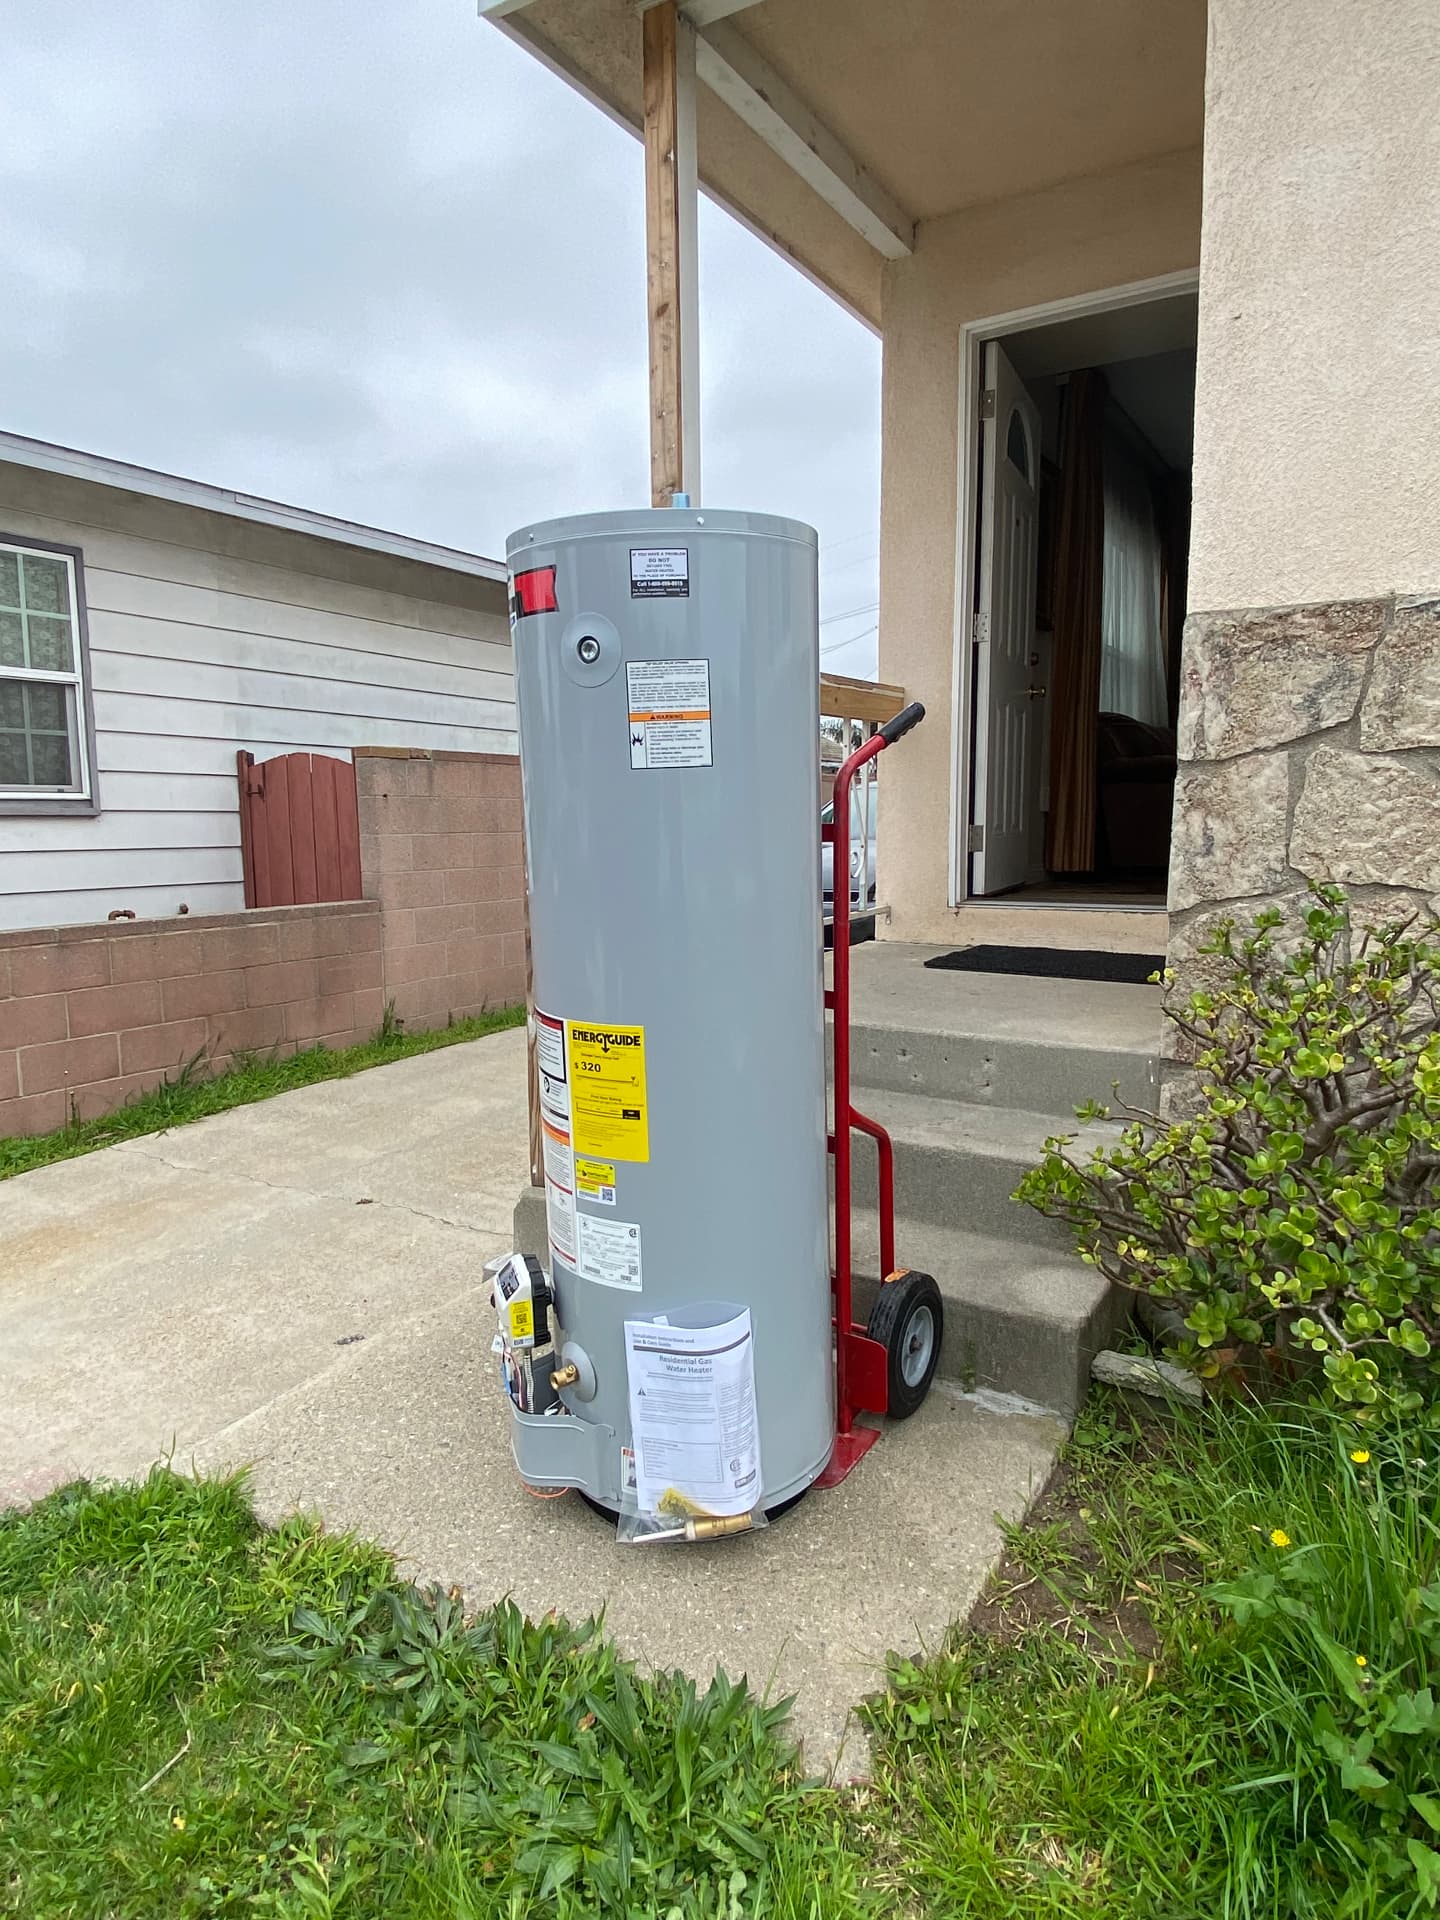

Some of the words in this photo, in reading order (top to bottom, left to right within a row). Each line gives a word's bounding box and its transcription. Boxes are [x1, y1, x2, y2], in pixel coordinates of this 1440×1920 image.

[572, 1029, 641, 1046] ENERGYGUIDE
[581, 1061, 601, 1072] 320
[659, 1355, 697, 1364] Residential
[666, 1365, 687, 1373] Water
